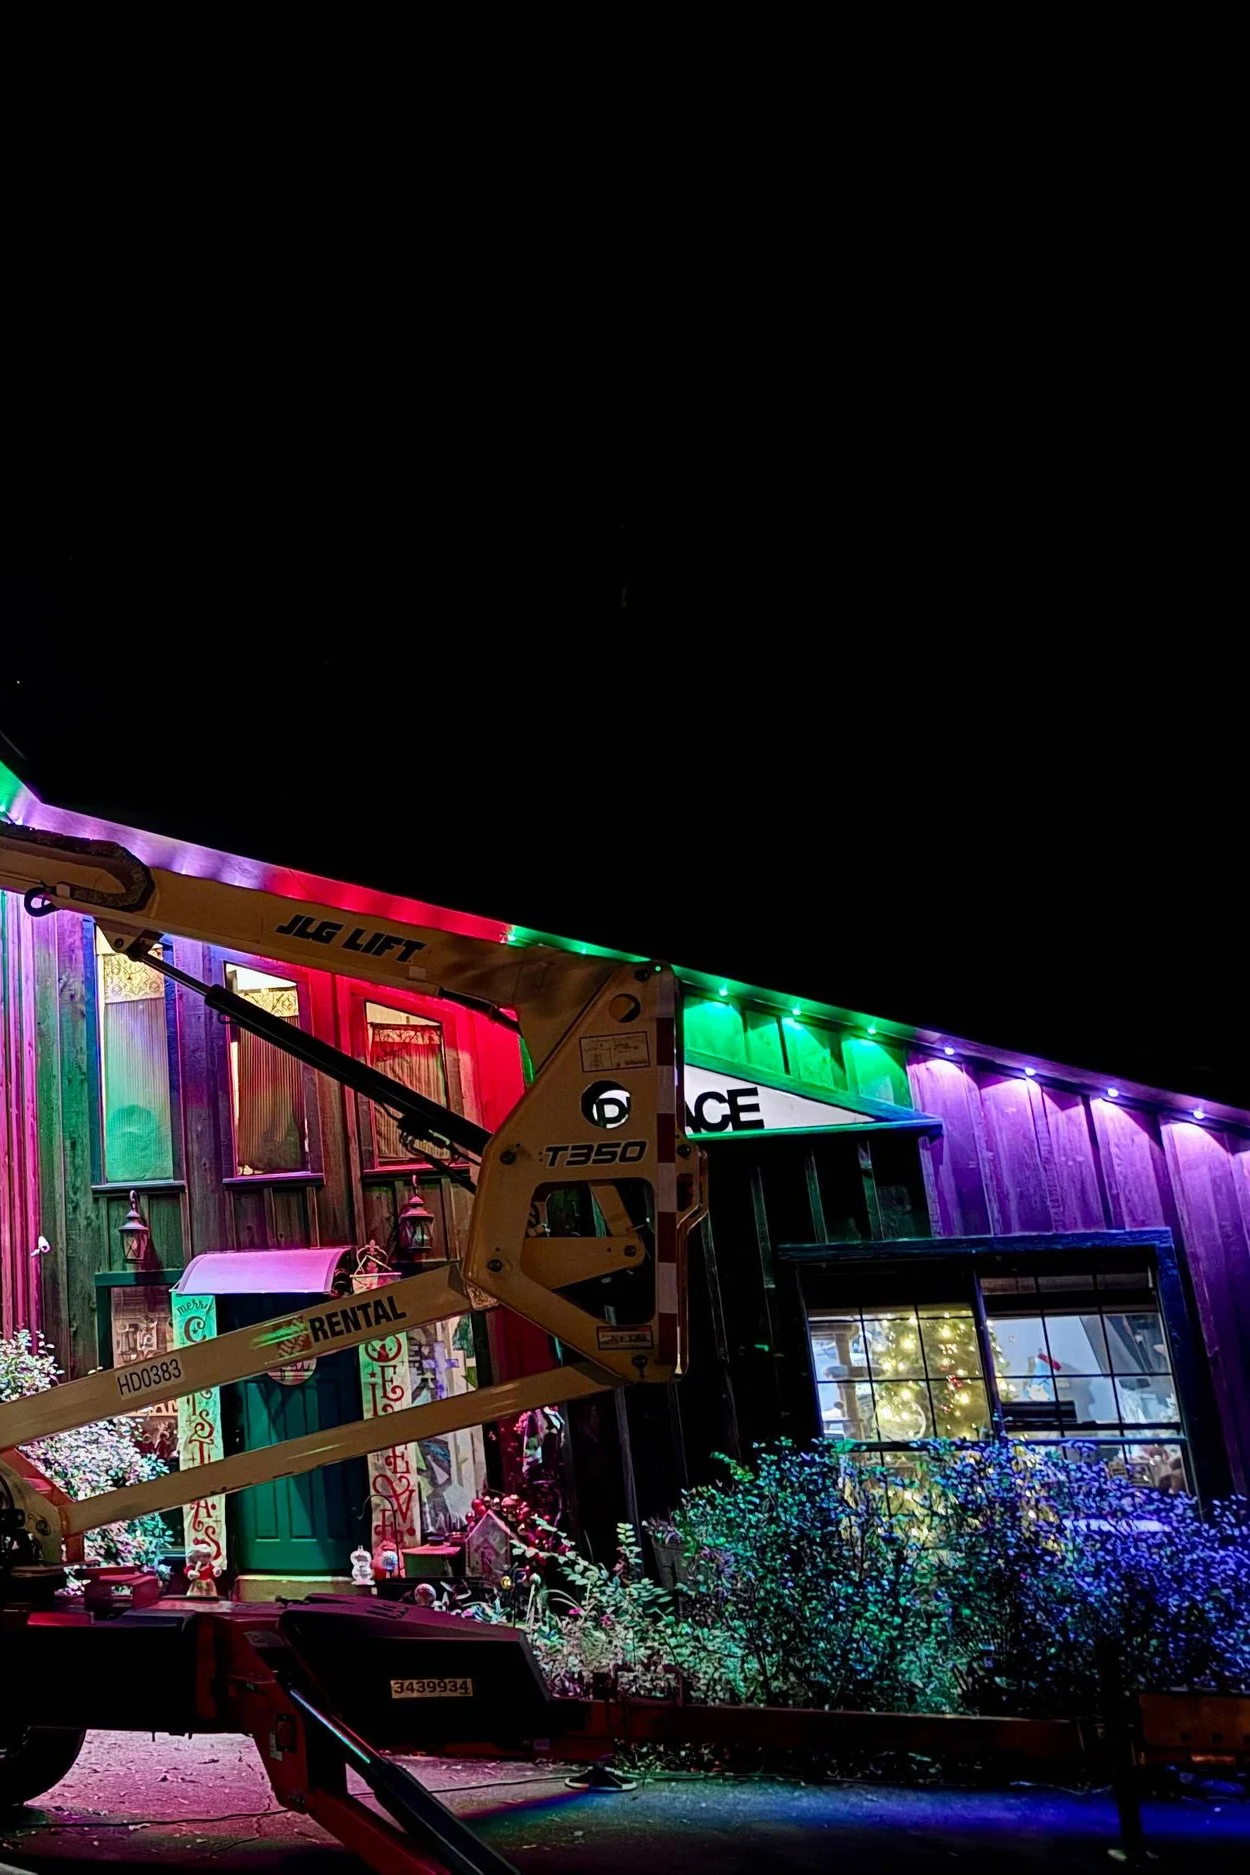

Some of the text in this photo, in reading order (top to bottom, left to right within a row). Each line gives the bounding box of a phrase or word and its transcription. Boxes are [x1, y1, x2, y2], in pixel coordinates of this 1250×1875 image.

[275, 914, 426, 962] JLG LIFT
[545, 1141, 647, 1168] T350
[308, 1295, 407, 1343] RENTAL
[116, 1358, 183, 1396] HD0383
[393, 1680, 470, 1696] 3439934
